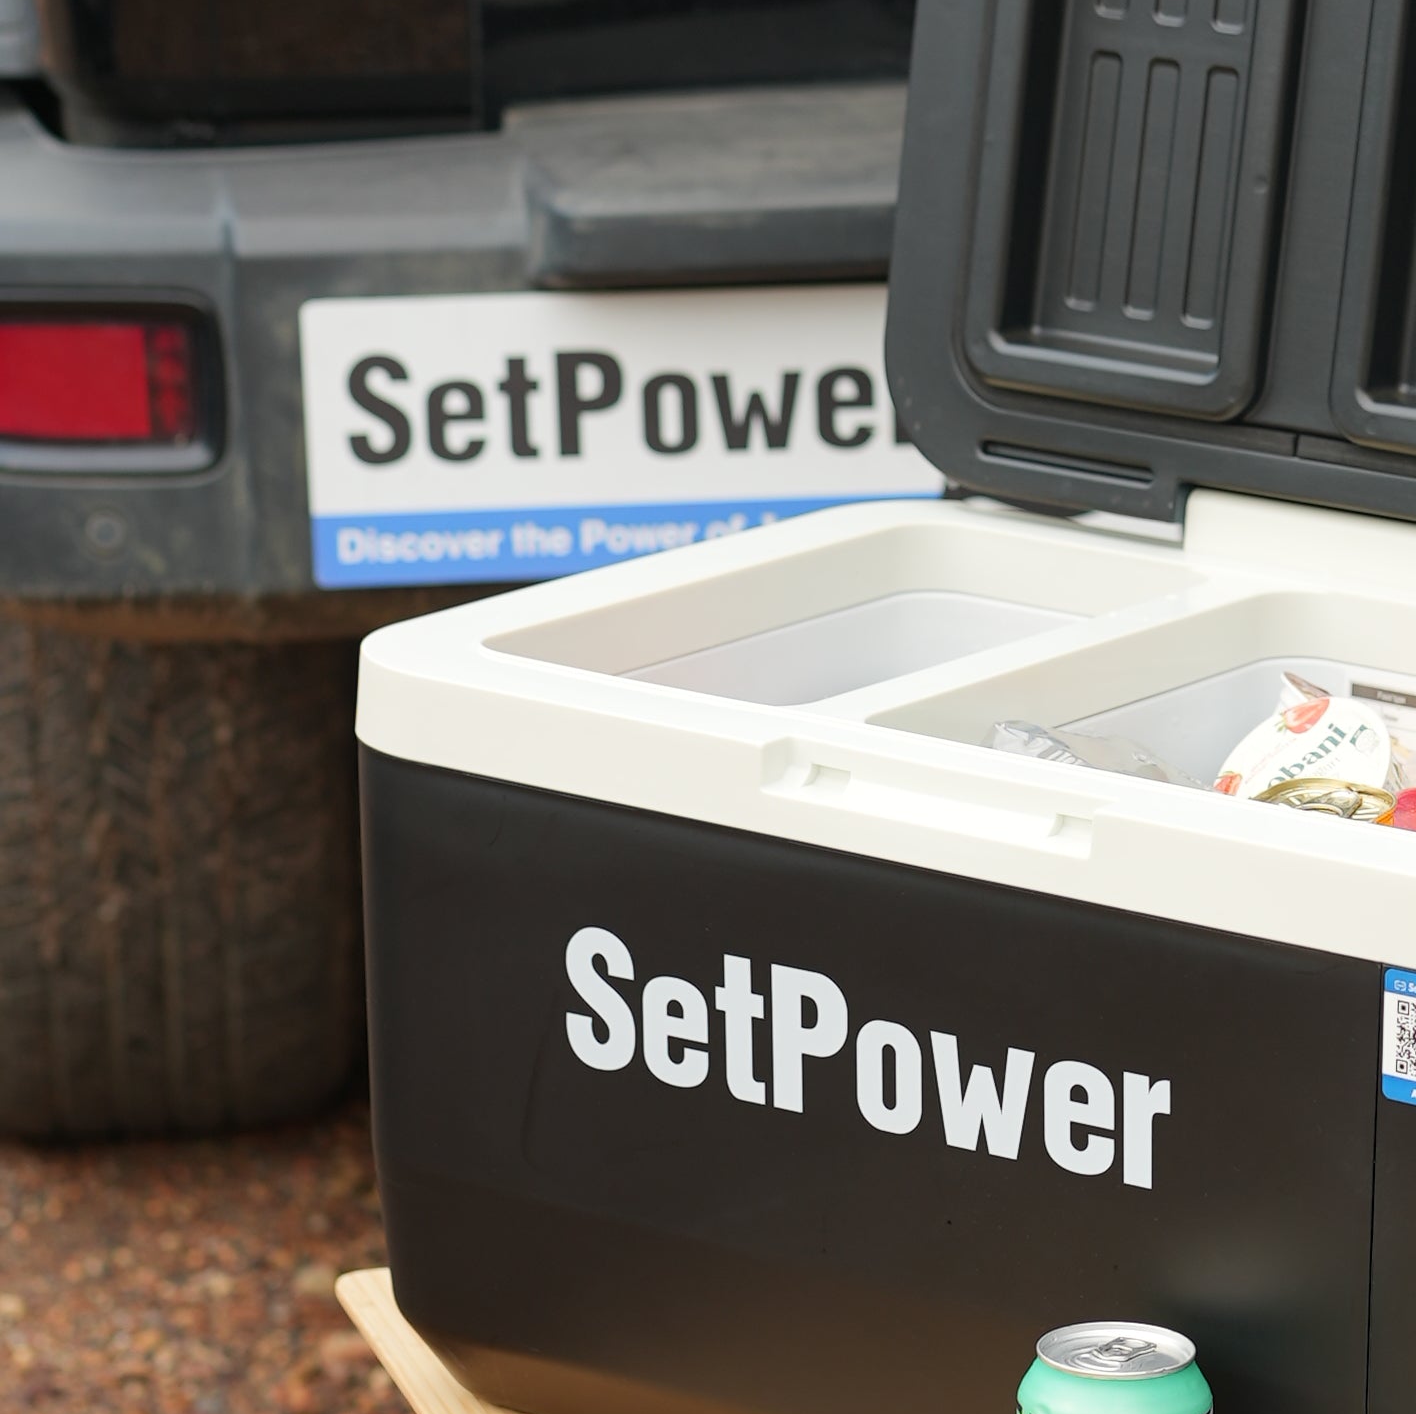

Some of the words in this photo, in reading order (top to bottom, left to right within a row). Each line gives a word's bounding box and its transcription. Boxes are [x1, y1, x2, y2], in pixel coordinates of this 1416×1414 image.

[337, 527, 504, 565] Discover
[511, 521, 572, 558] the
[580, 518, 698, 554] Power
[565, 926, 1171, 1190] SetPower
